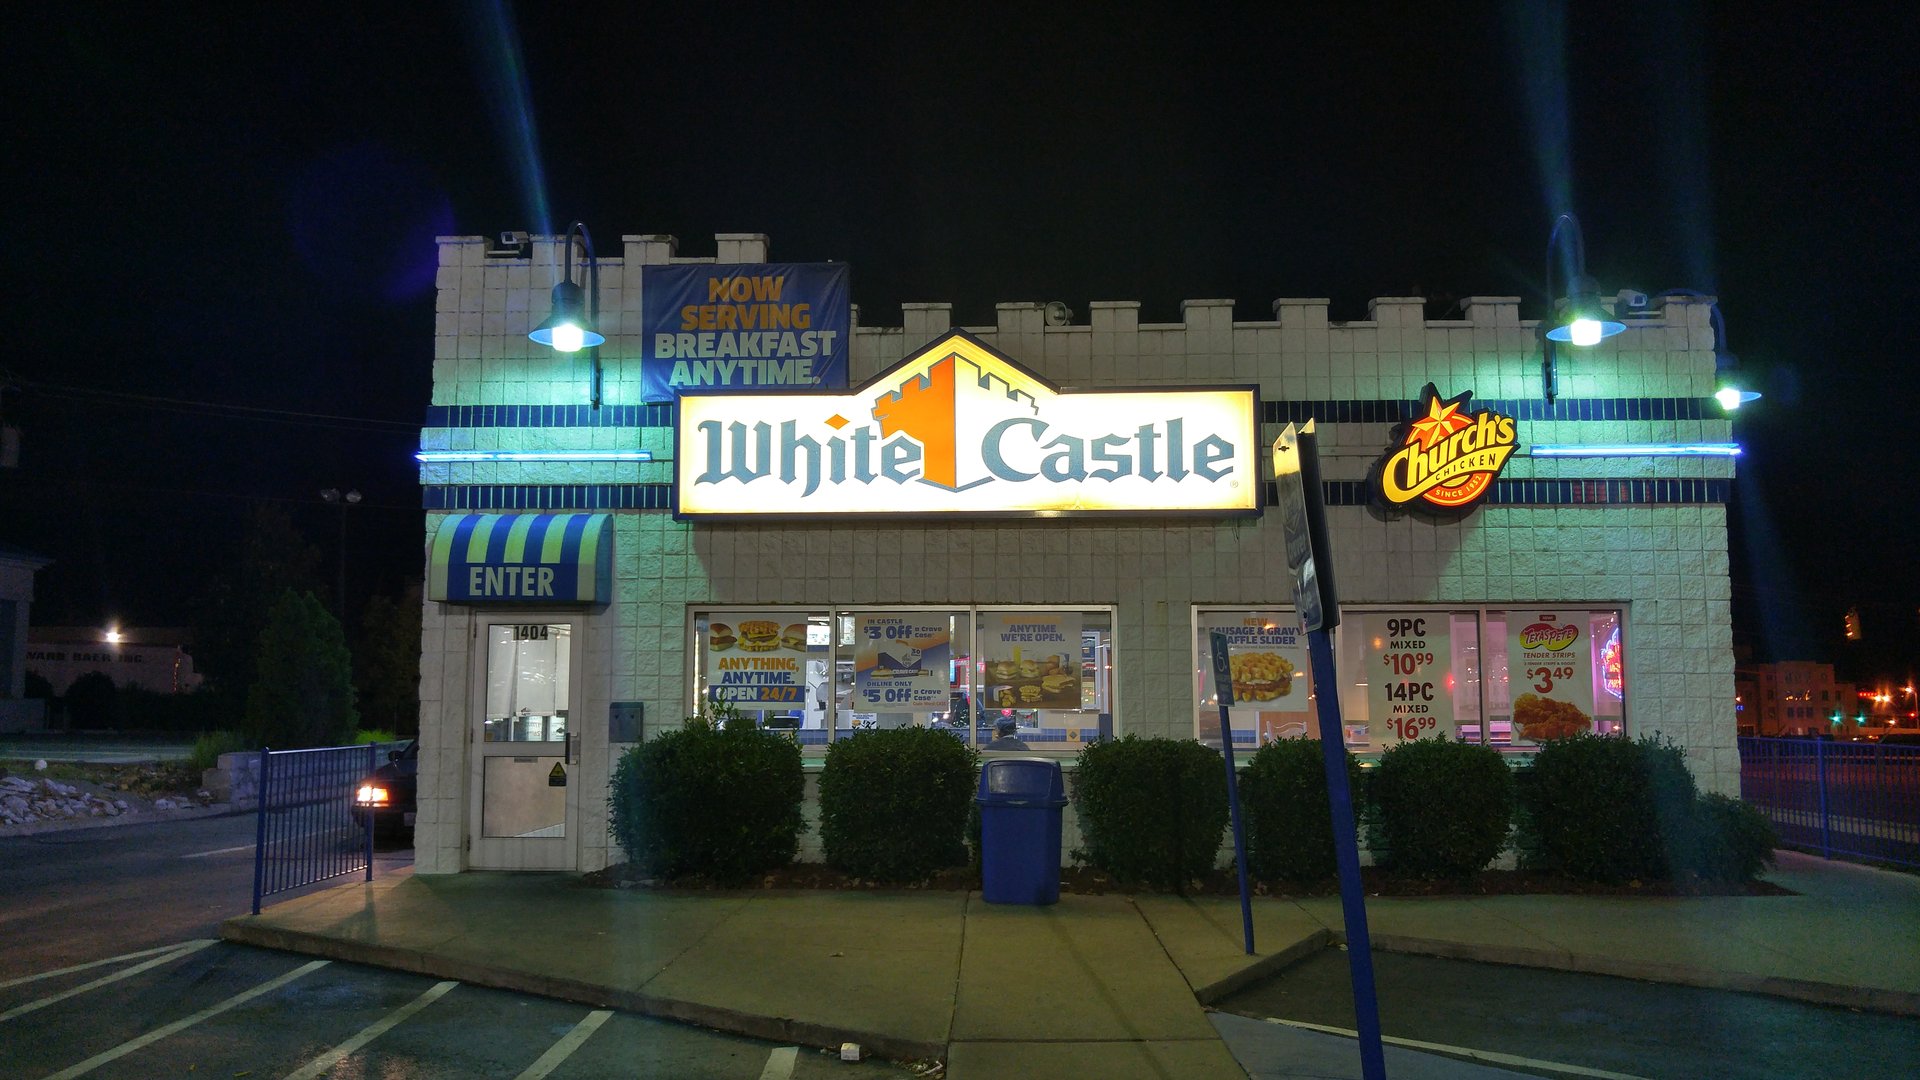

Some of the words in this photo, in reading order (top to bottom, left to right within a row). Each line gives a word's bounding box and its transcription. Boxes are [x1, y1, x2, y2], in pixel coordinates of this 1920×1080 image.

[708, 275, 785, 303] NOW
[680, 303, 811, 331] SERVING
[654, 331, 837, 359] BREAKFAST
[668, 359, 822, 387] ANYTIME.
[694, 413, 925, 498] White
[981, 416, 1235, 484] Castle
[1383, 412, 1515, 503] Church's
[1435, 453, 1497, 481] CHICKEN
[1435, 489, 1464, 498] SINCE
[468, 566, 555, 597] ENTER
[1009, 624, 1057, 633] ANYTIME
[1243, 617, 1269, 626] NEW
[1386, 618, 1427, 638] 9PC
[513, 625, 549, 641] 1404
[863, 625, 882, 640] $3
[1000, 633, 1033, 642] WE'RE
[1034, 633, 1066, 642] OPEN.
[1256, 627, 1265, 636] &
[1226, 636, 1257, 645] AFFLE
[1259, 636, 1296, 645] SLIDER
[1390, 640, 1426, 650] MIXED
[718, 657, 800, 672] ANYTHING,
[721, 671, 796, 685] ANYTIME.
[715, 686, 758, 701] OPEN
[761, 686, 797, 701] 24/7
[862, 688, 881, 703] $5
[1384, 682, 1434, 702] 14PC
[1392, 704, 1429, 714] MIXED
